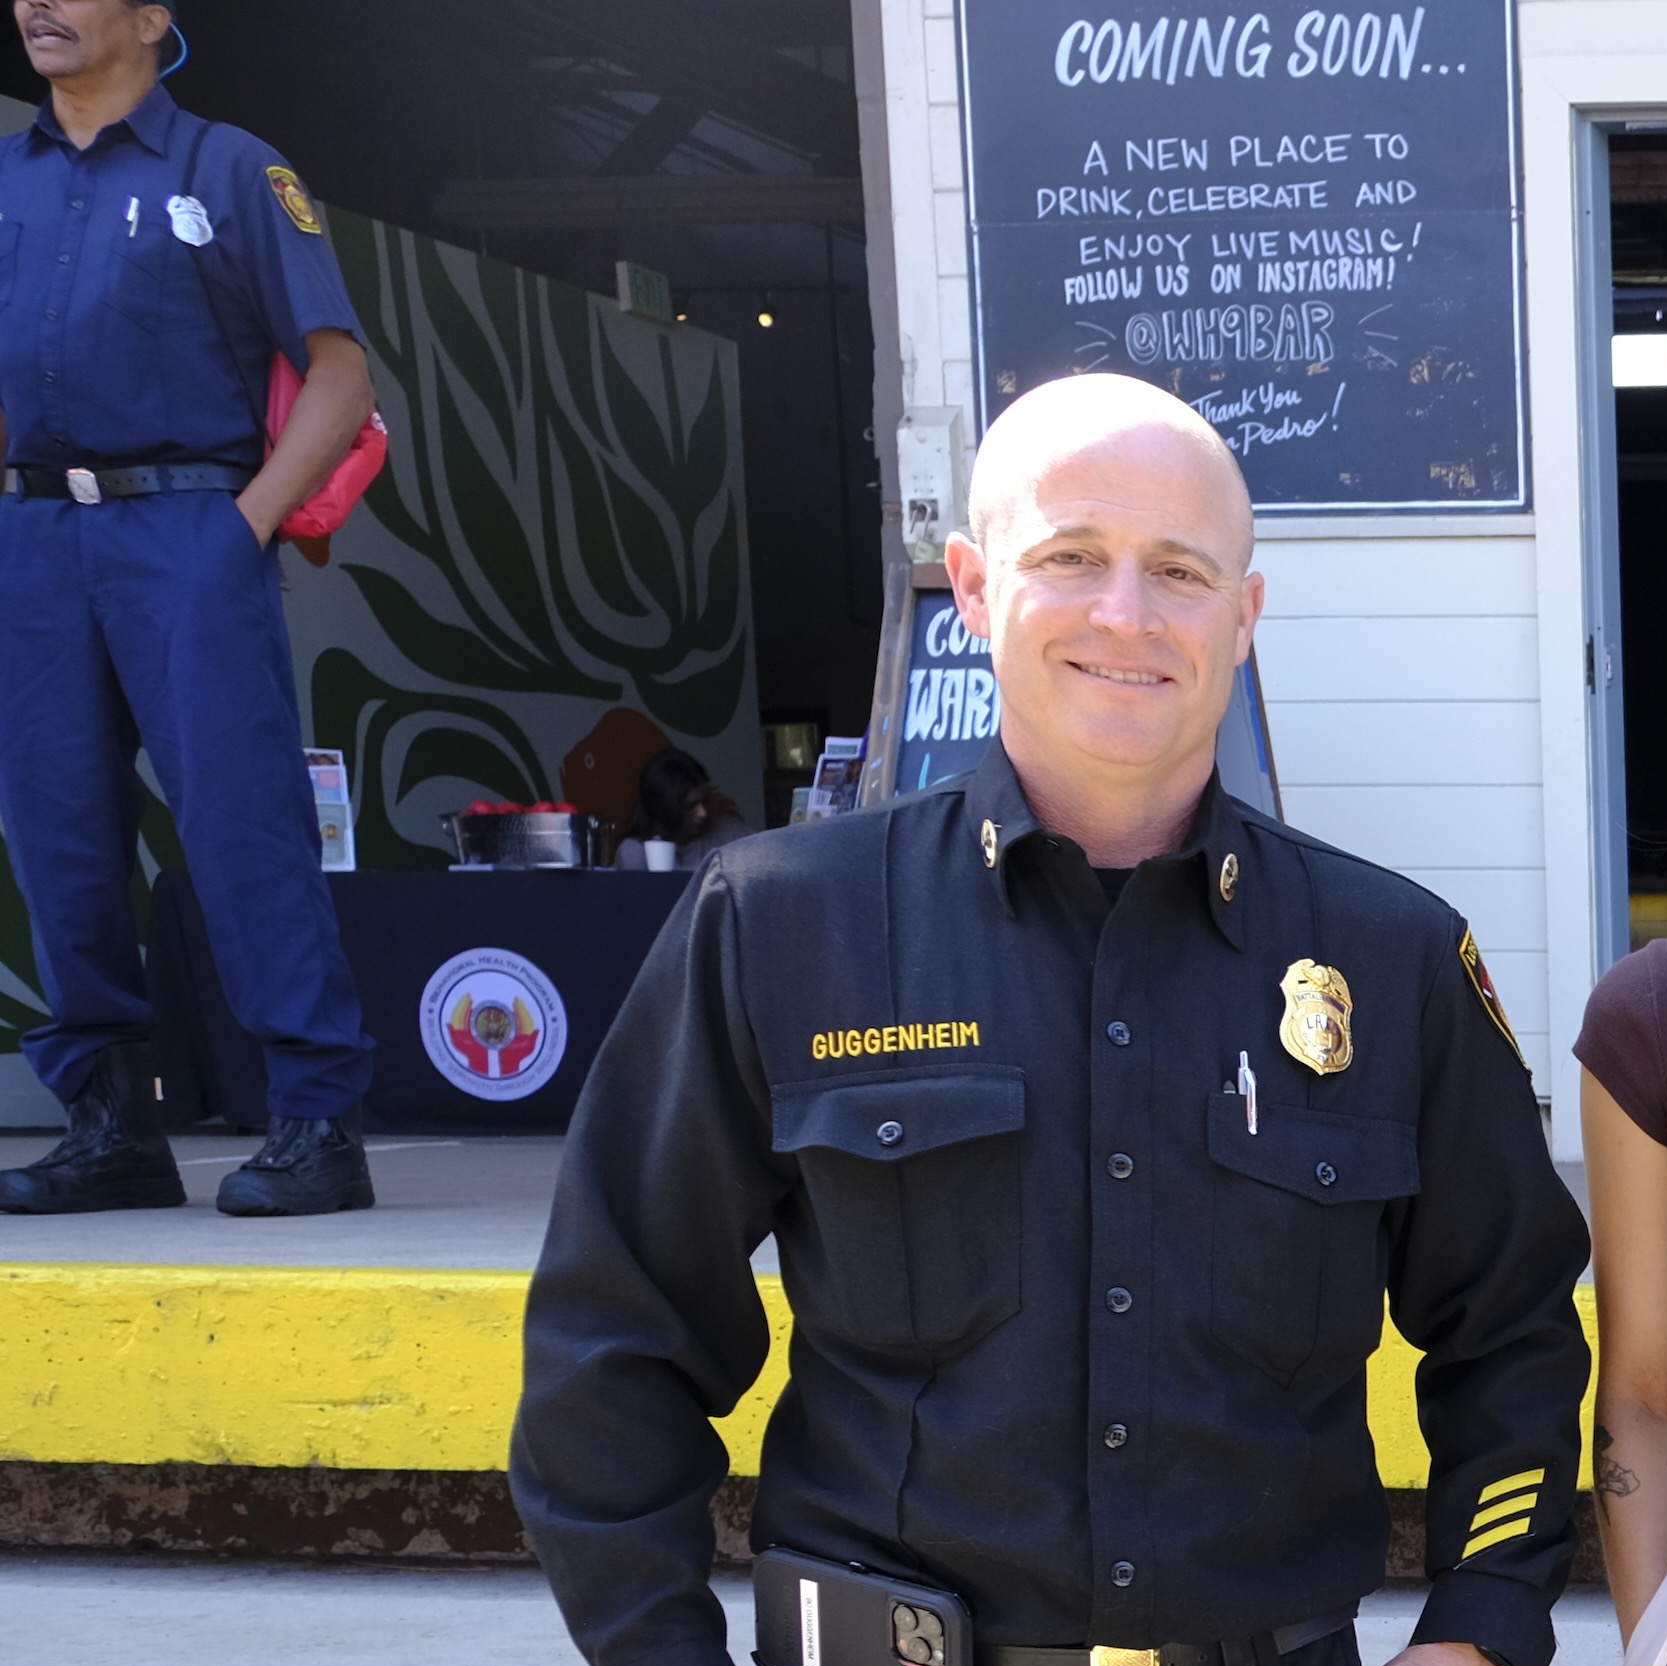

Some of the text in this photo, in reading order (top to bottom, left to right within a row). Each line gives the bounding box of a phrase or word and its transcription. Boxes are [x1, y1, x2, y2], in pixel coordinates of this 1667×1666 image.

[1055, 6, 1466, 87] COMING SOON...
[1083, 133, 1409, 176] A NEW PLACE TO
[1148, 180, 1328, 216] CELEBRATE
[1355, 180, 1416, 207] AND
[1080, 222, 1422, 265] ENJOY LIVE MUSIC!
[1064, 256, 1396, 305] FOLLOW US ON INSTAGRAM!
[1125, 301, 1335, 364] @WH9BAR
[1189, 382, 1303, 424] Thank You
[478, 956, 519, 971] HEALTH
[812, 1022, 980, 1060] GUGGENHEIM
